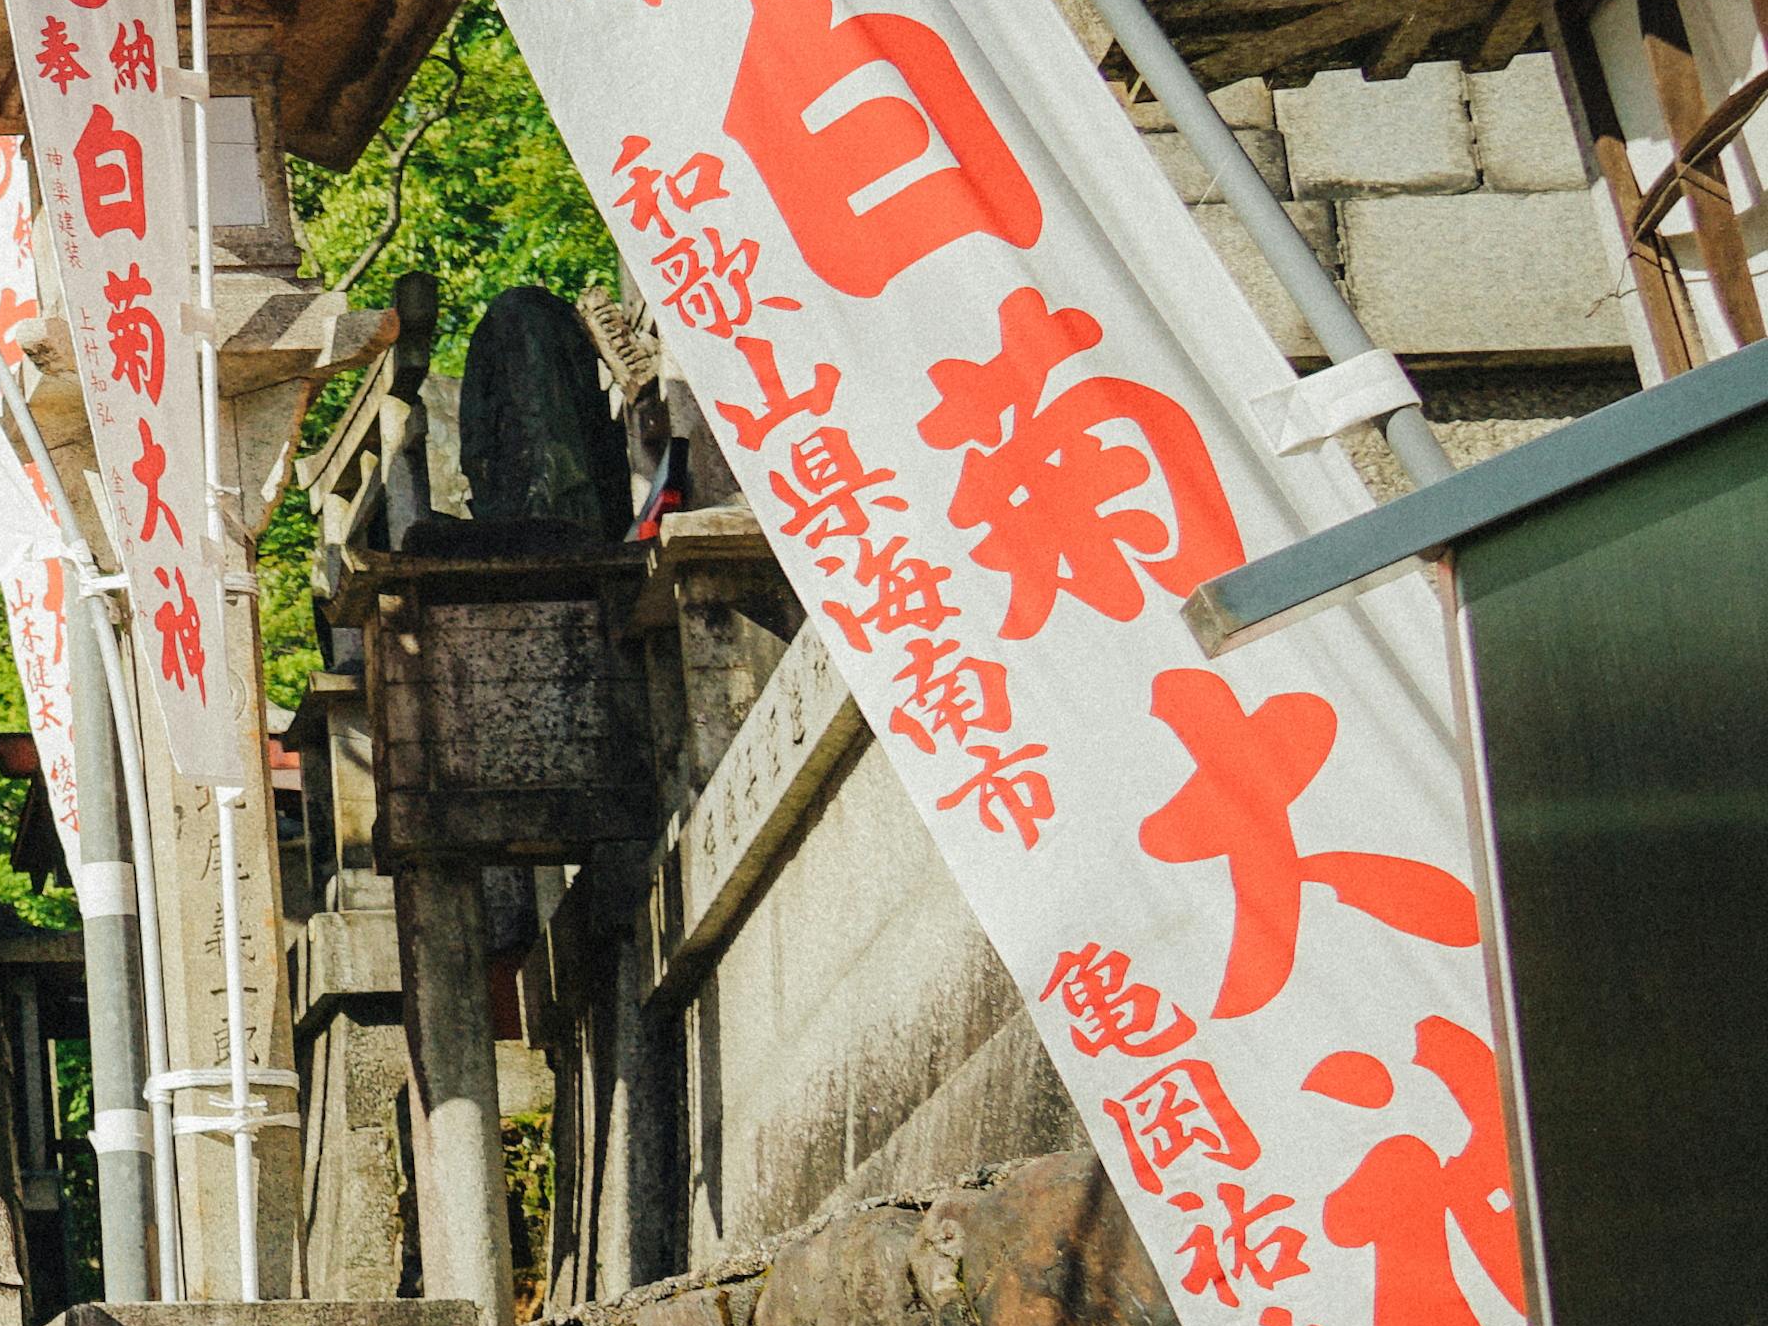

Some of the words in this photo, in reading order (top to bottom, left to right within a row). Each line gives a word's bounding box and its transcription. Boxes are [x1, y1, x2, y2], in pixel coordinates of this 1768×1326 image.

[35, 15, 157, 95] 奉納
[73, 106, 206, 705] 白菊大神
[613, 141, 1055, 849] 和歌山県海南市
